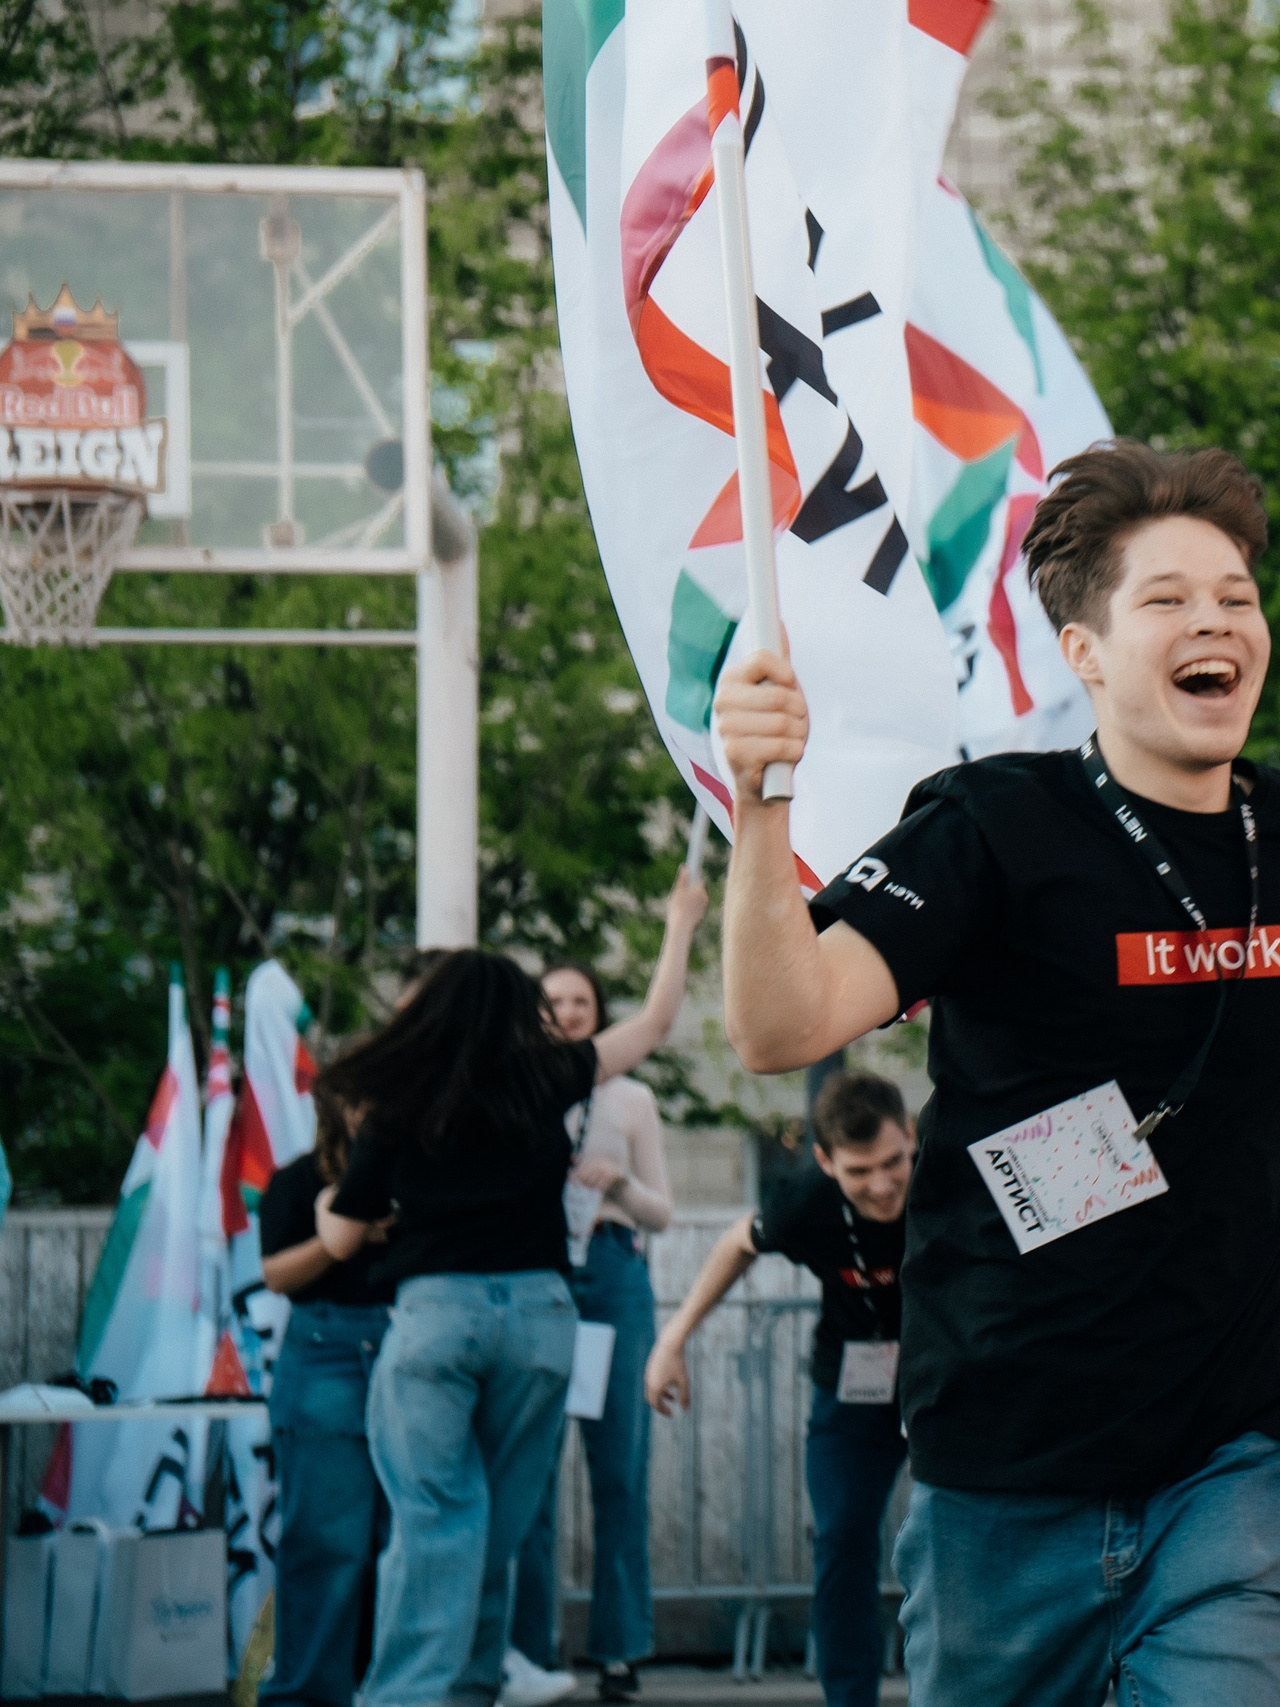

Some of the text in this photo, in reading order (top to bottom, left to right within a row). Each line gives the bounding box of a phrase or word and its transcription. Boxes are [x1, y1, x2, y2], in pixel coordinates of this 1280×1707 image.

[1114, 804, 1148, 843] NETI
[1145, 933, 1176, 975] It
[985, 1148, 1046, 1233] АРТИСТ
